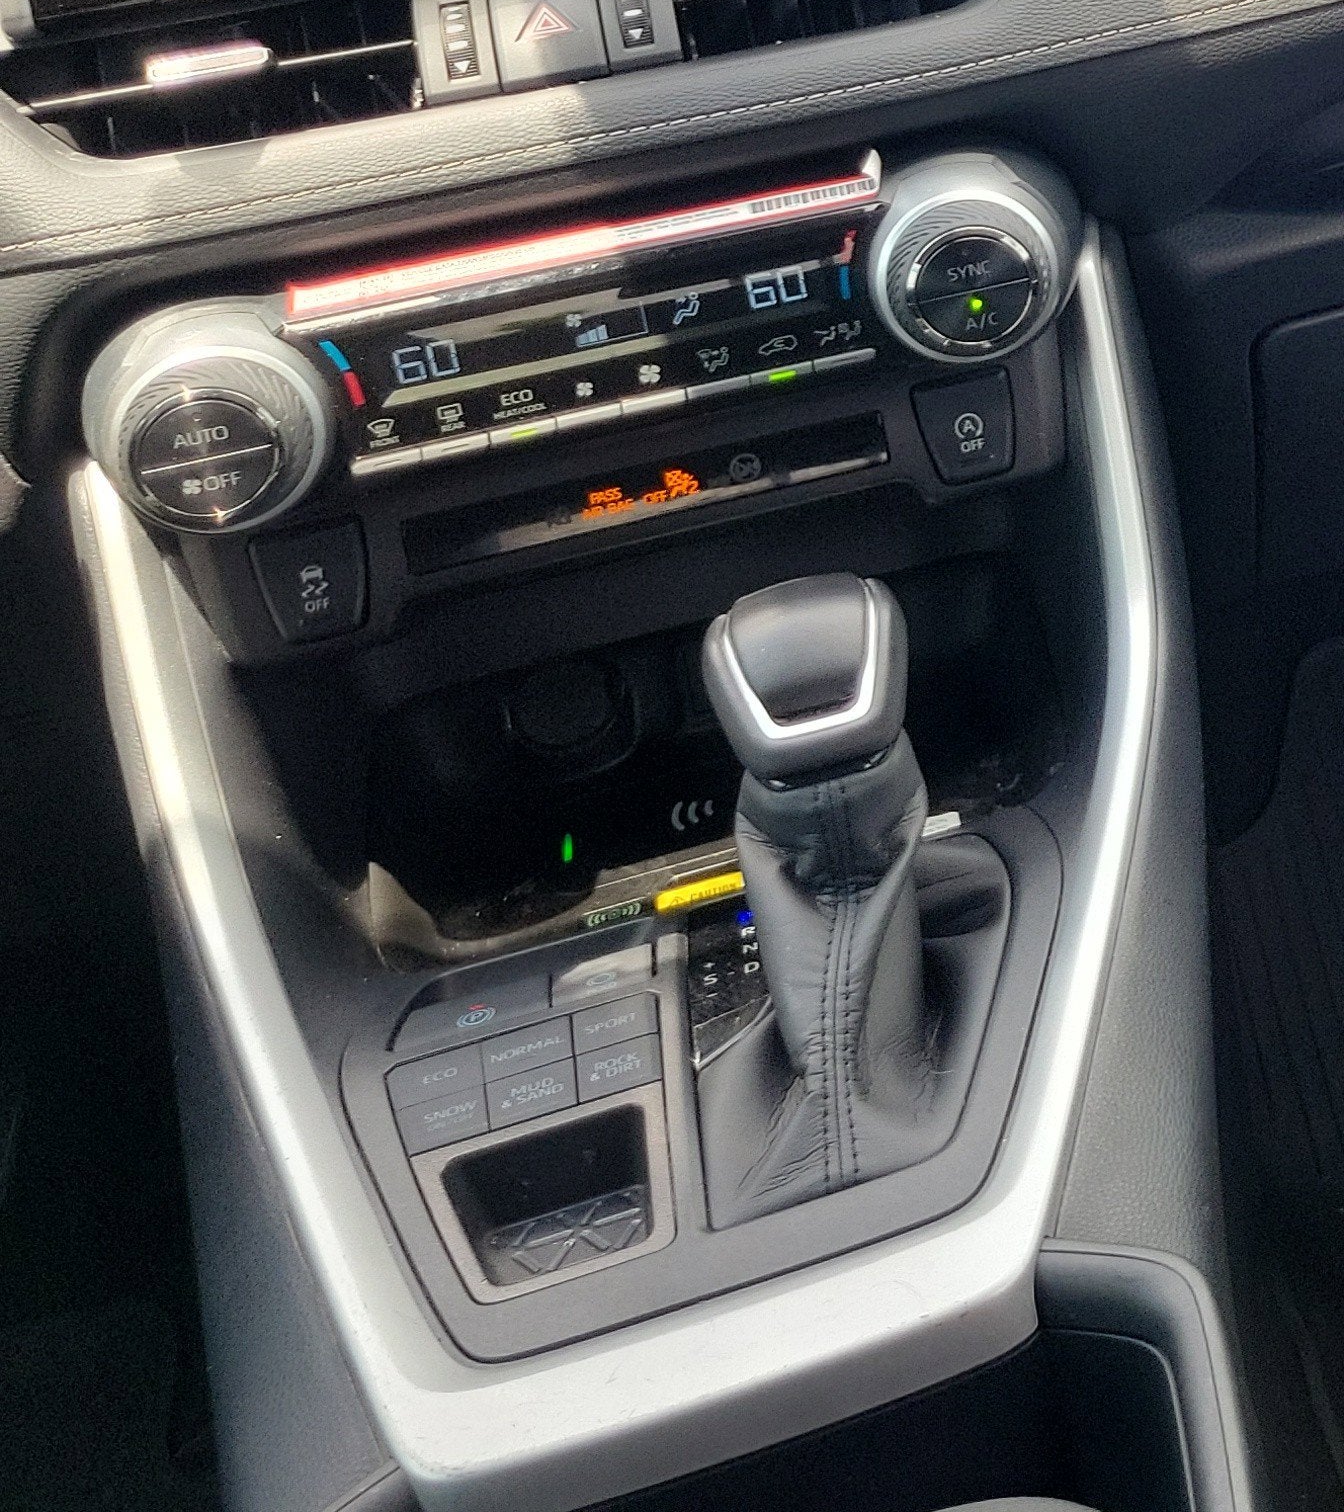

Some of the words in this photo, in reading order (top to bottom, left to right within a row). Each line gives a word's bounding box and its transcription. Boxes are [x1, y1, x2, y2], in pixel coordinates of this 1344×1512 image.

[947, 260, 992, 282] SYNC
[745, 266, 808, 309] 60
[965, 311, 999, 332] A/C
[392, 338, 461, 384] 60
[501, 389, 534, 406] ECO
[493, 402, 547, 421] HEAT/COOL
[173, 426, 230, 449] AUTO
[369, 434, 400, 450] FRONT
[960, 439, 985, 453] OFF
[203, 470, 242, 491] OFF
[590, 487, 623, 505] PASS
[643, 490, 667, 505] OFF
[304, 597, 331, 614] OFF
[690, 881, 737, 899] CAUTION
[741, 926, 756, 938] R
[742, 941, 759, 955] N
[743, 961, 760, 975] D
[703, 973, 718, 986] S
[584, 1012, 638, 1036] SPORT
[490, 1035, 567, 1064] NORMAL
[594, 1052, 639, 1072] ROCK
[605, 1059, 643, 1080] DIRT
[422, 1067, 458, 1085] ECO
[510, 1077, 555, 1097] MUD
[515, 1083, 565, 1105] SAND
[423, 1099, 478, 1123] SNOW
